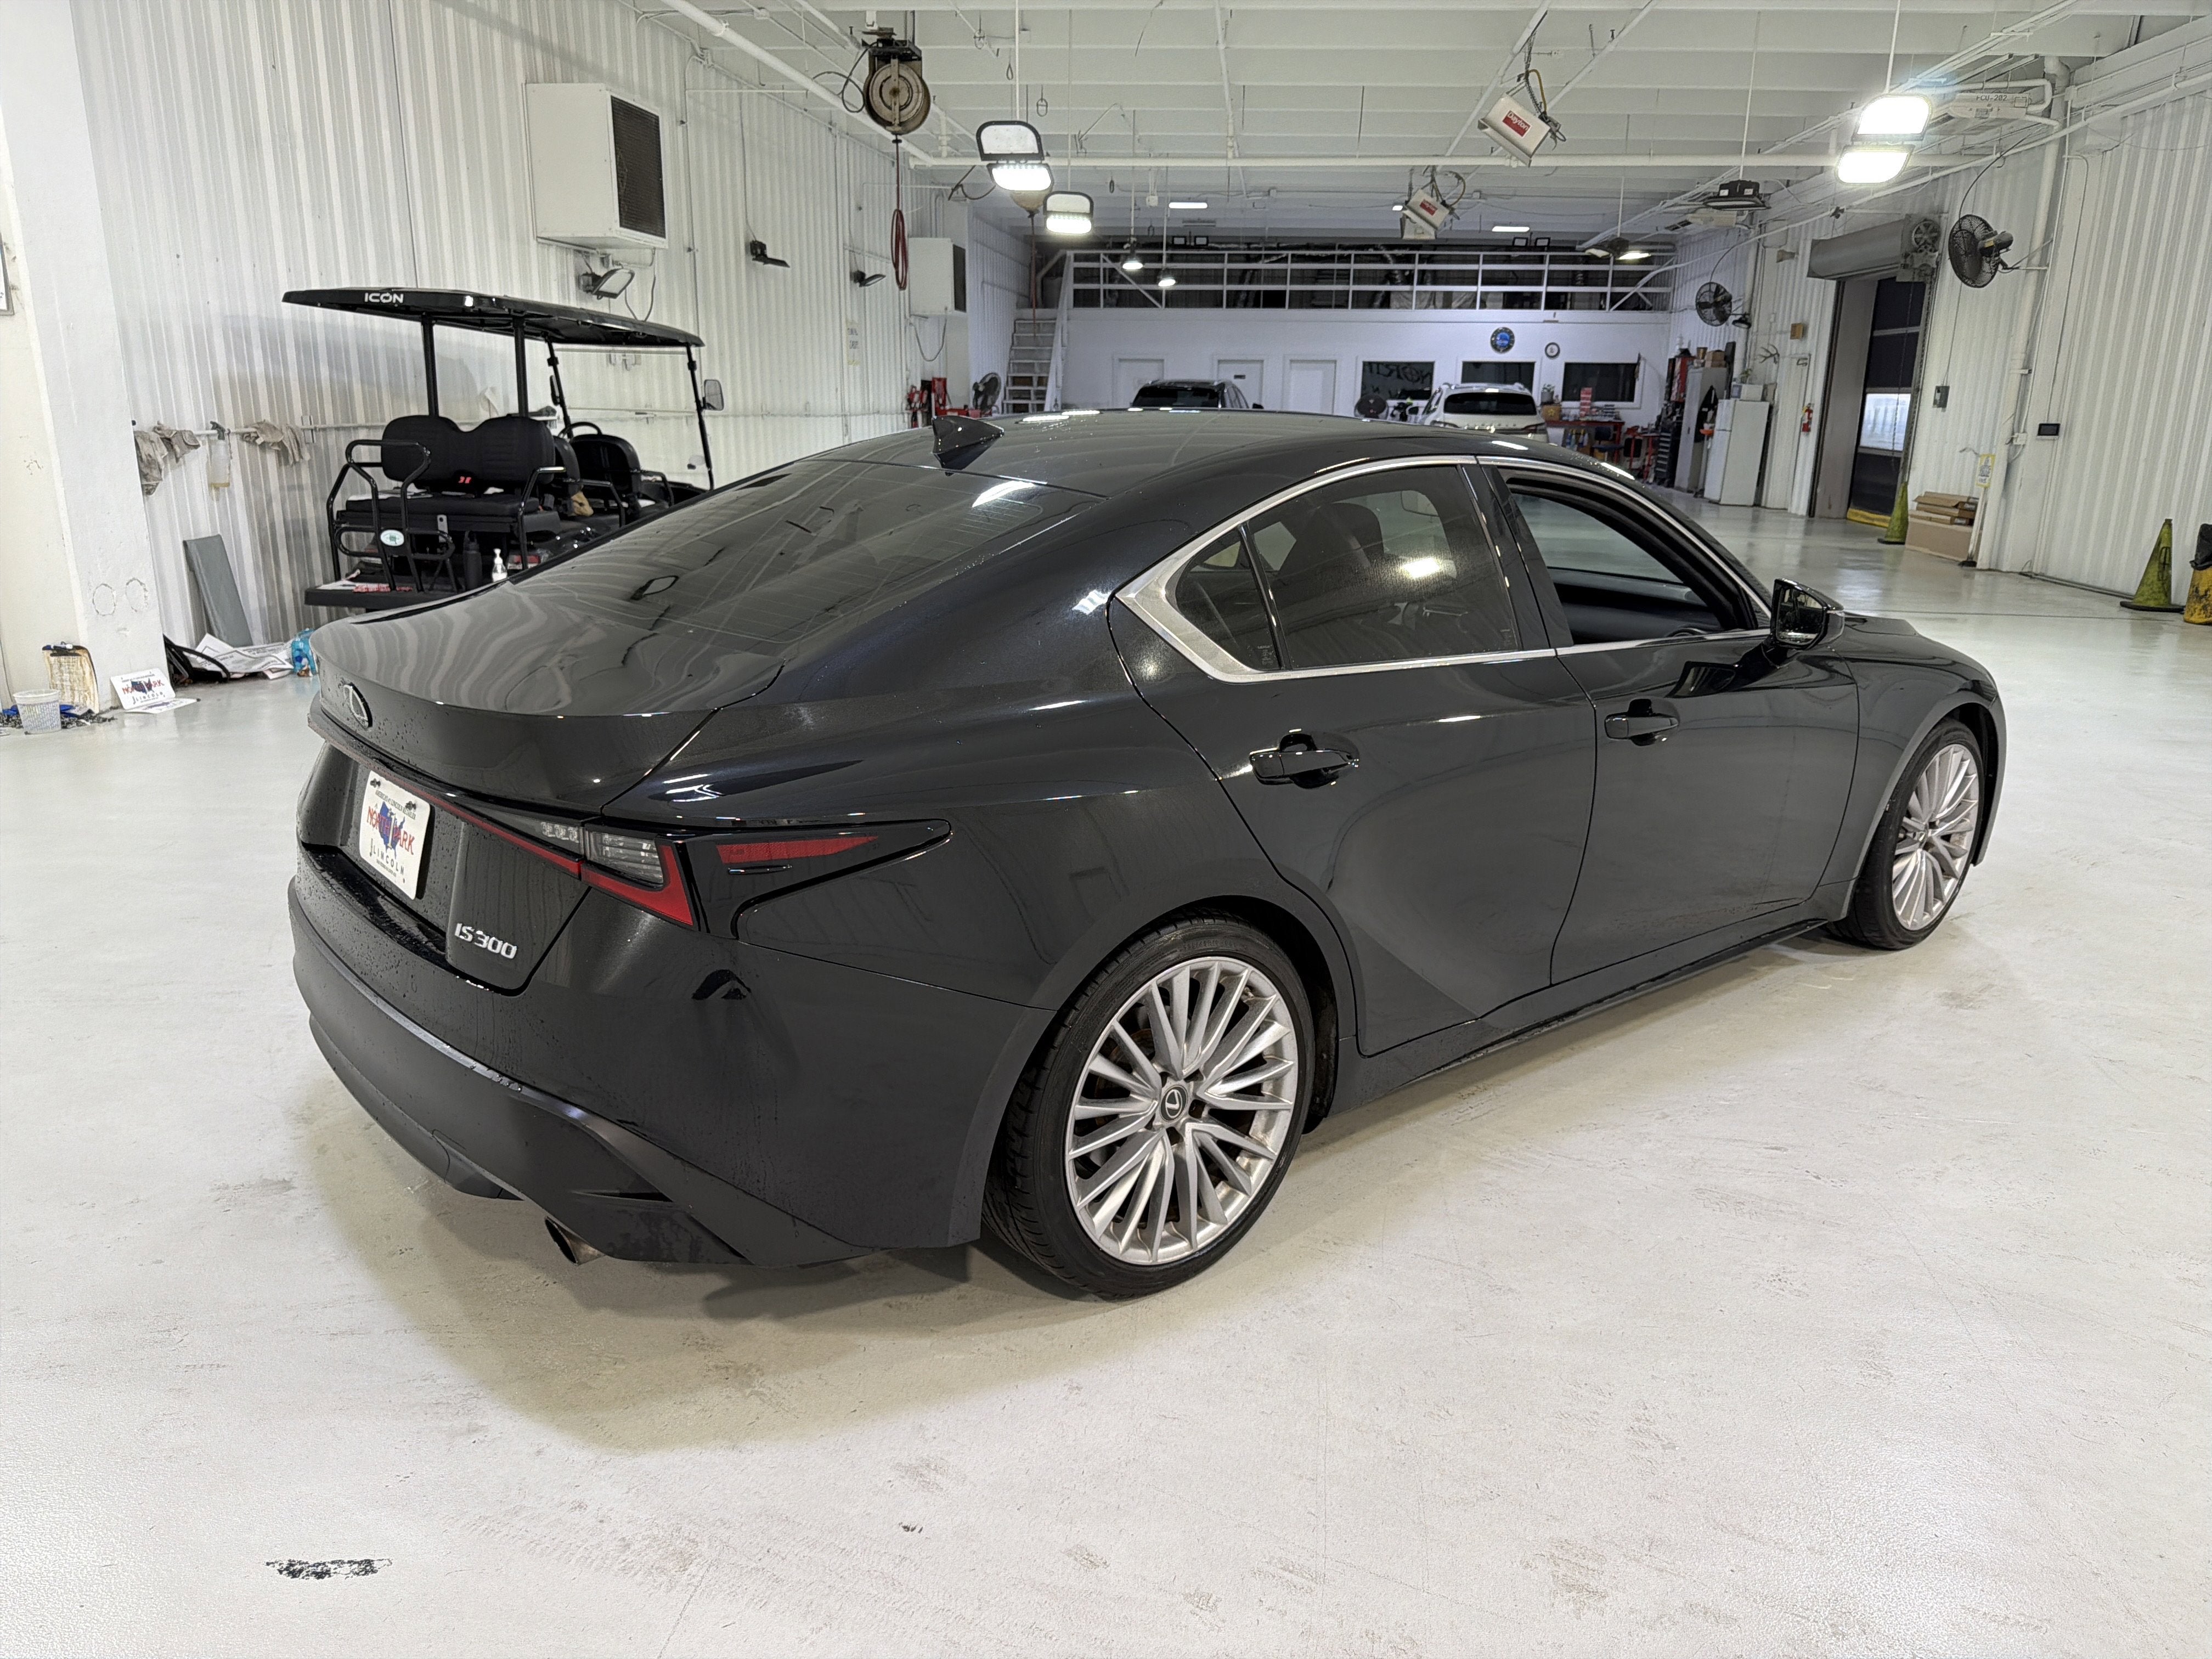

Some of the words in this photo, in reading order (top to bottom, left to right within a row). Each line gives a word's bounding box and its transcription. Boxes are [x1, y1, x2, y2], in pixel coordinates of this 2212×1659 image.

[1507, 112, 1528, 130] Dayton
[364, 292, 404, 303] ICON
[366, 806, 390, 837] NORTH
[393, 825, 415, 855] PARK
[373, 845, 404, 876] LINCOLN
[474, 930, 517, 959] 300
